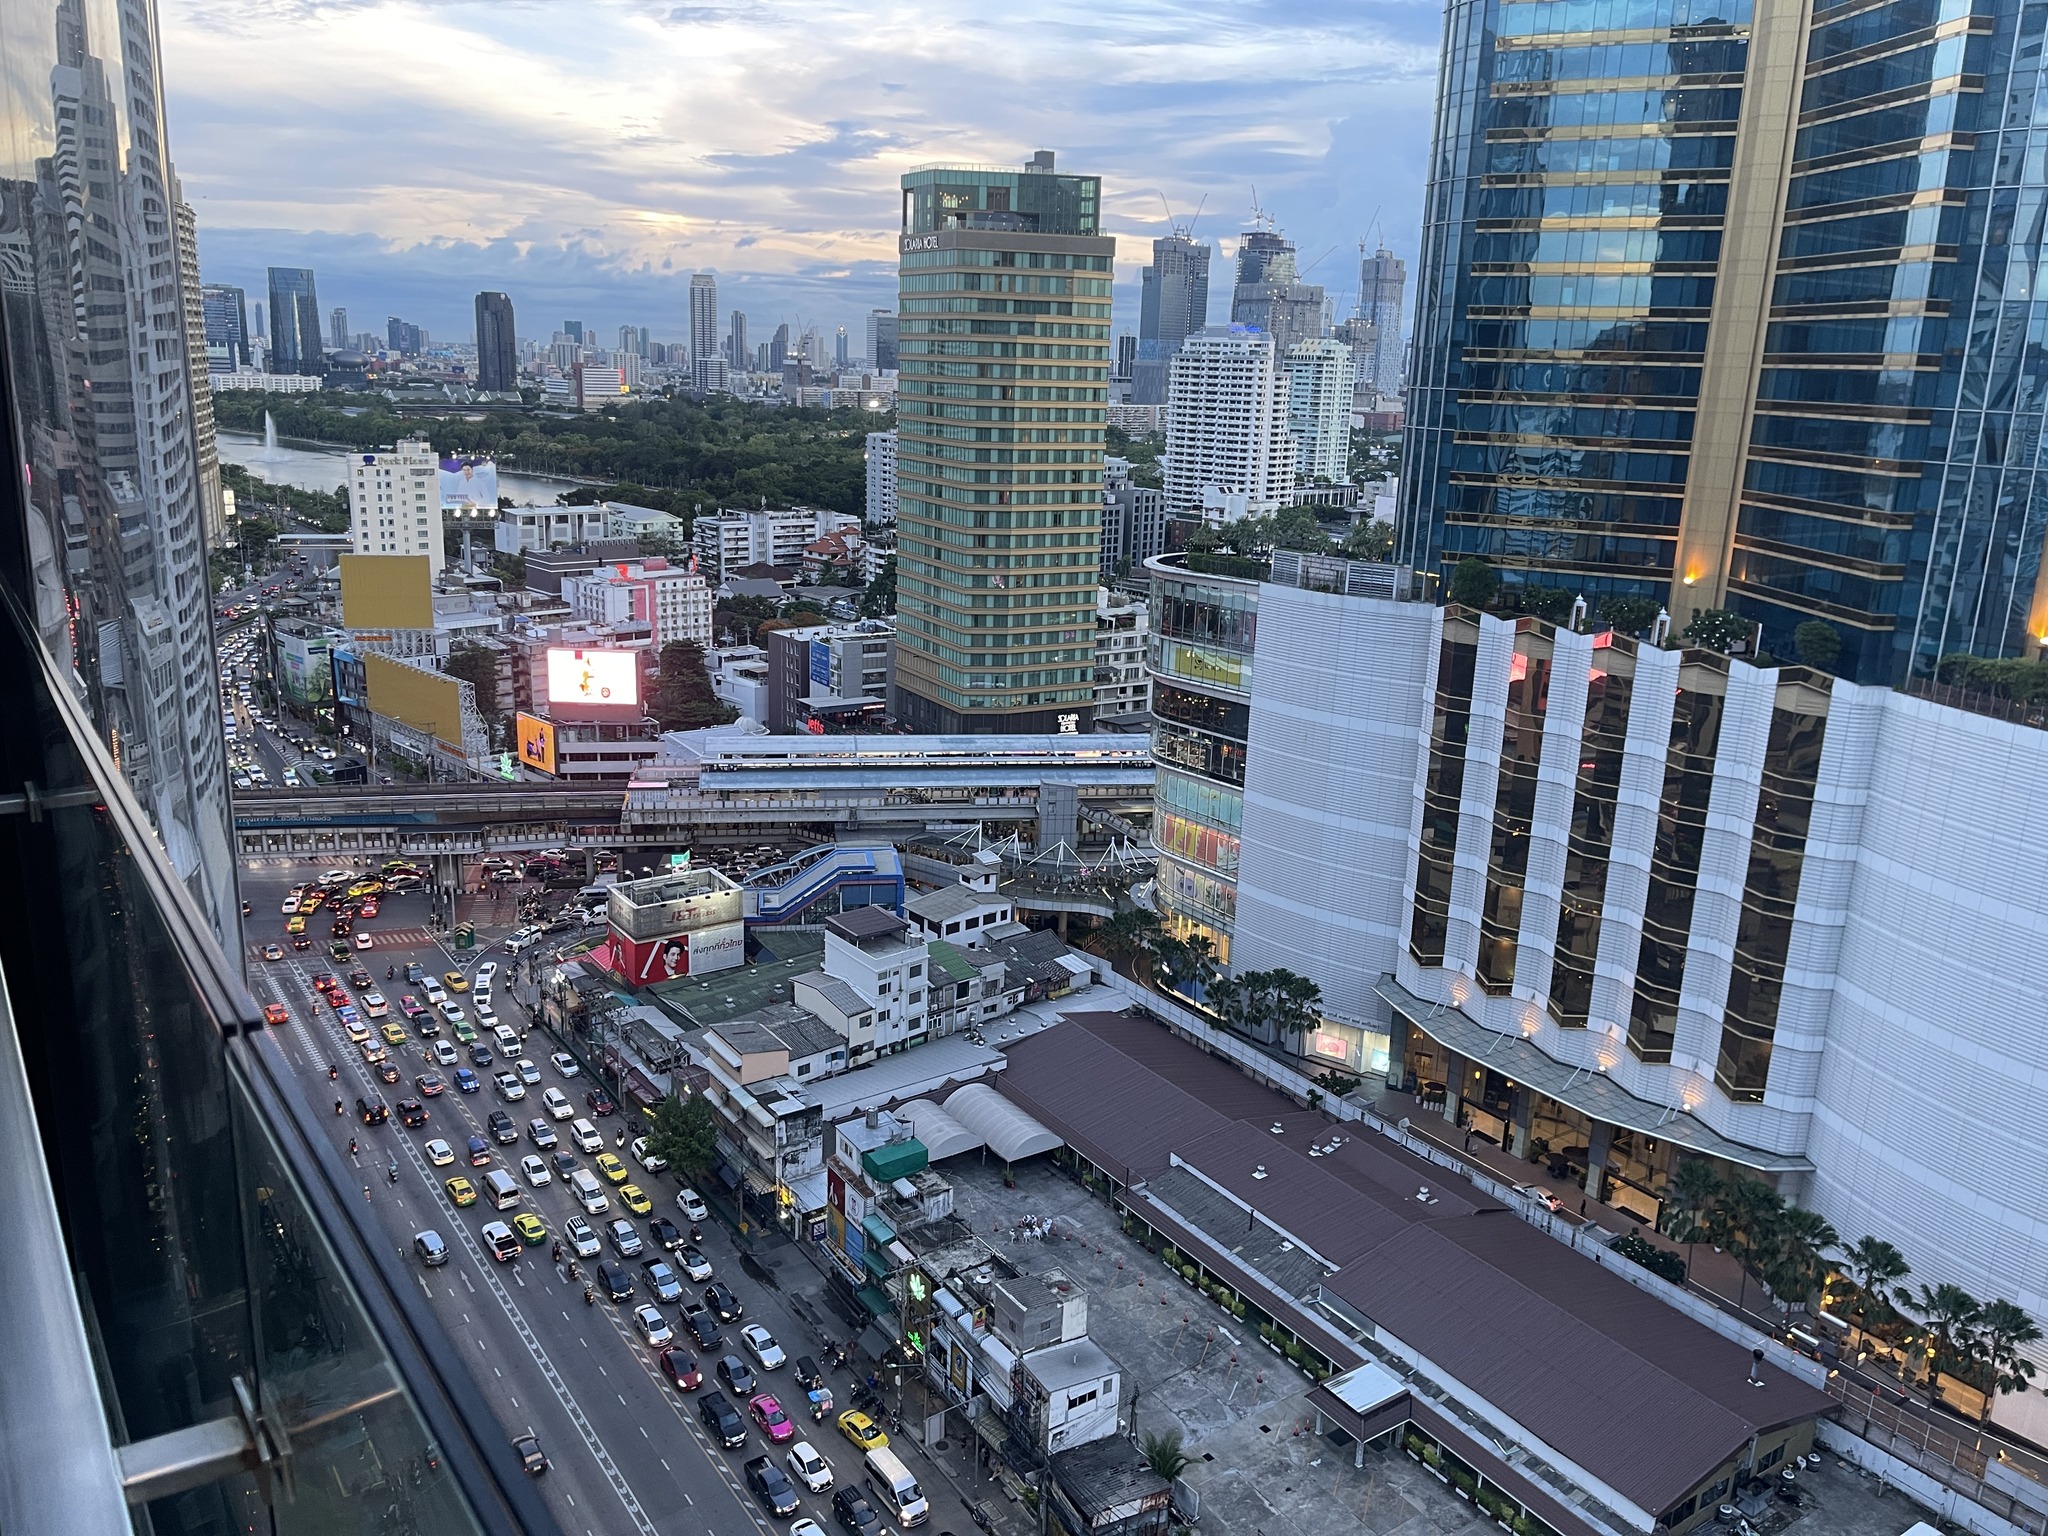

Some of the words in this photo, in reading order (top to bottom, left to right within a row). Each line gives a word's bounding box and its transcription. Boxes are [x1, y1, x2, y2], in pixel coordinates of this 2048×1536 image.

[923, 236, 939, 249] HOTEL
[378, 456, 401, 465] Park
[403, 456, 429, 465] Plaza
[692, 938, 743, 955] ส่งทุกที่ทั่วไทย
